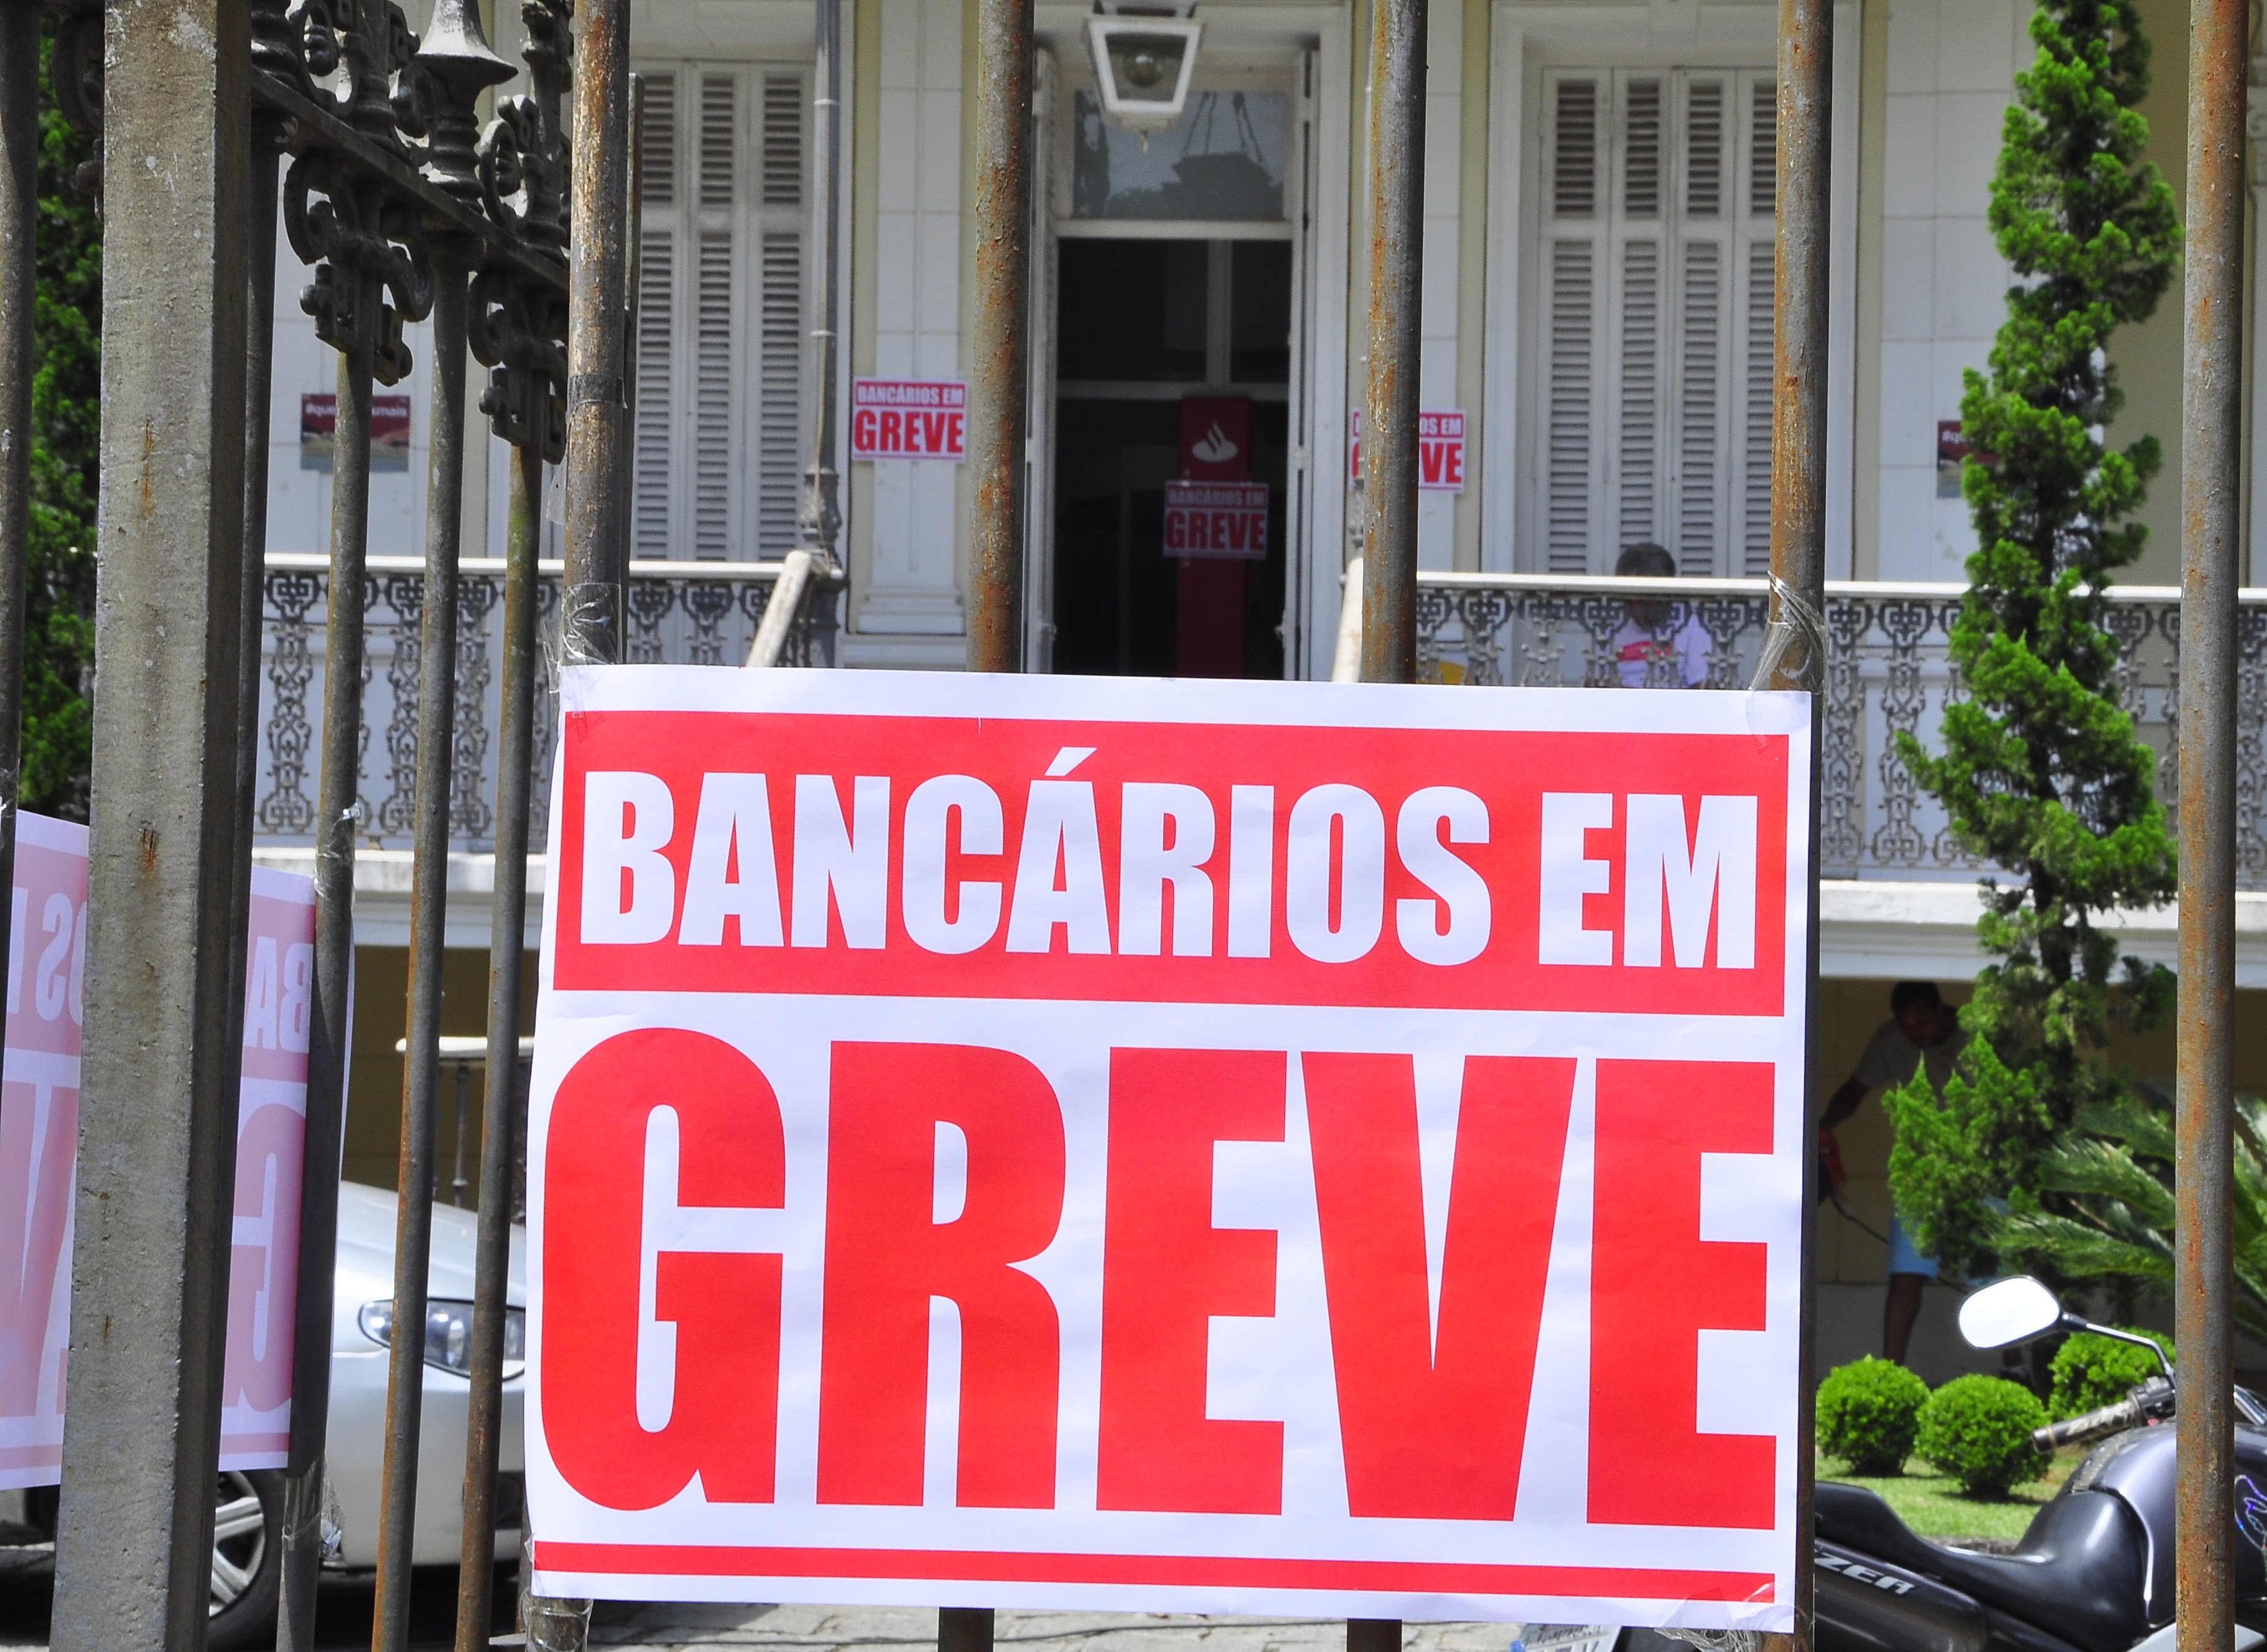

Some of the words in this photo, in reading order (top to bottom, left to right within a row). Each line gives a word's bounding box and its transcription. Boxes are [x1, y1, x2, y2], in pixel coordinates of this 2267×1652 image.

[943, 387, 963, 404] EM
[855, 410, 963, 453] GREVE
[1166, 511, 1265, 550] GREVE
[580, 747, 1491, 967] BANCÁRIOS
[1538, 792, 1758, 970] EM
[541, 1028, 1776, 1529] GREVE
[1814, 1552, 1916, 1595] ZER
